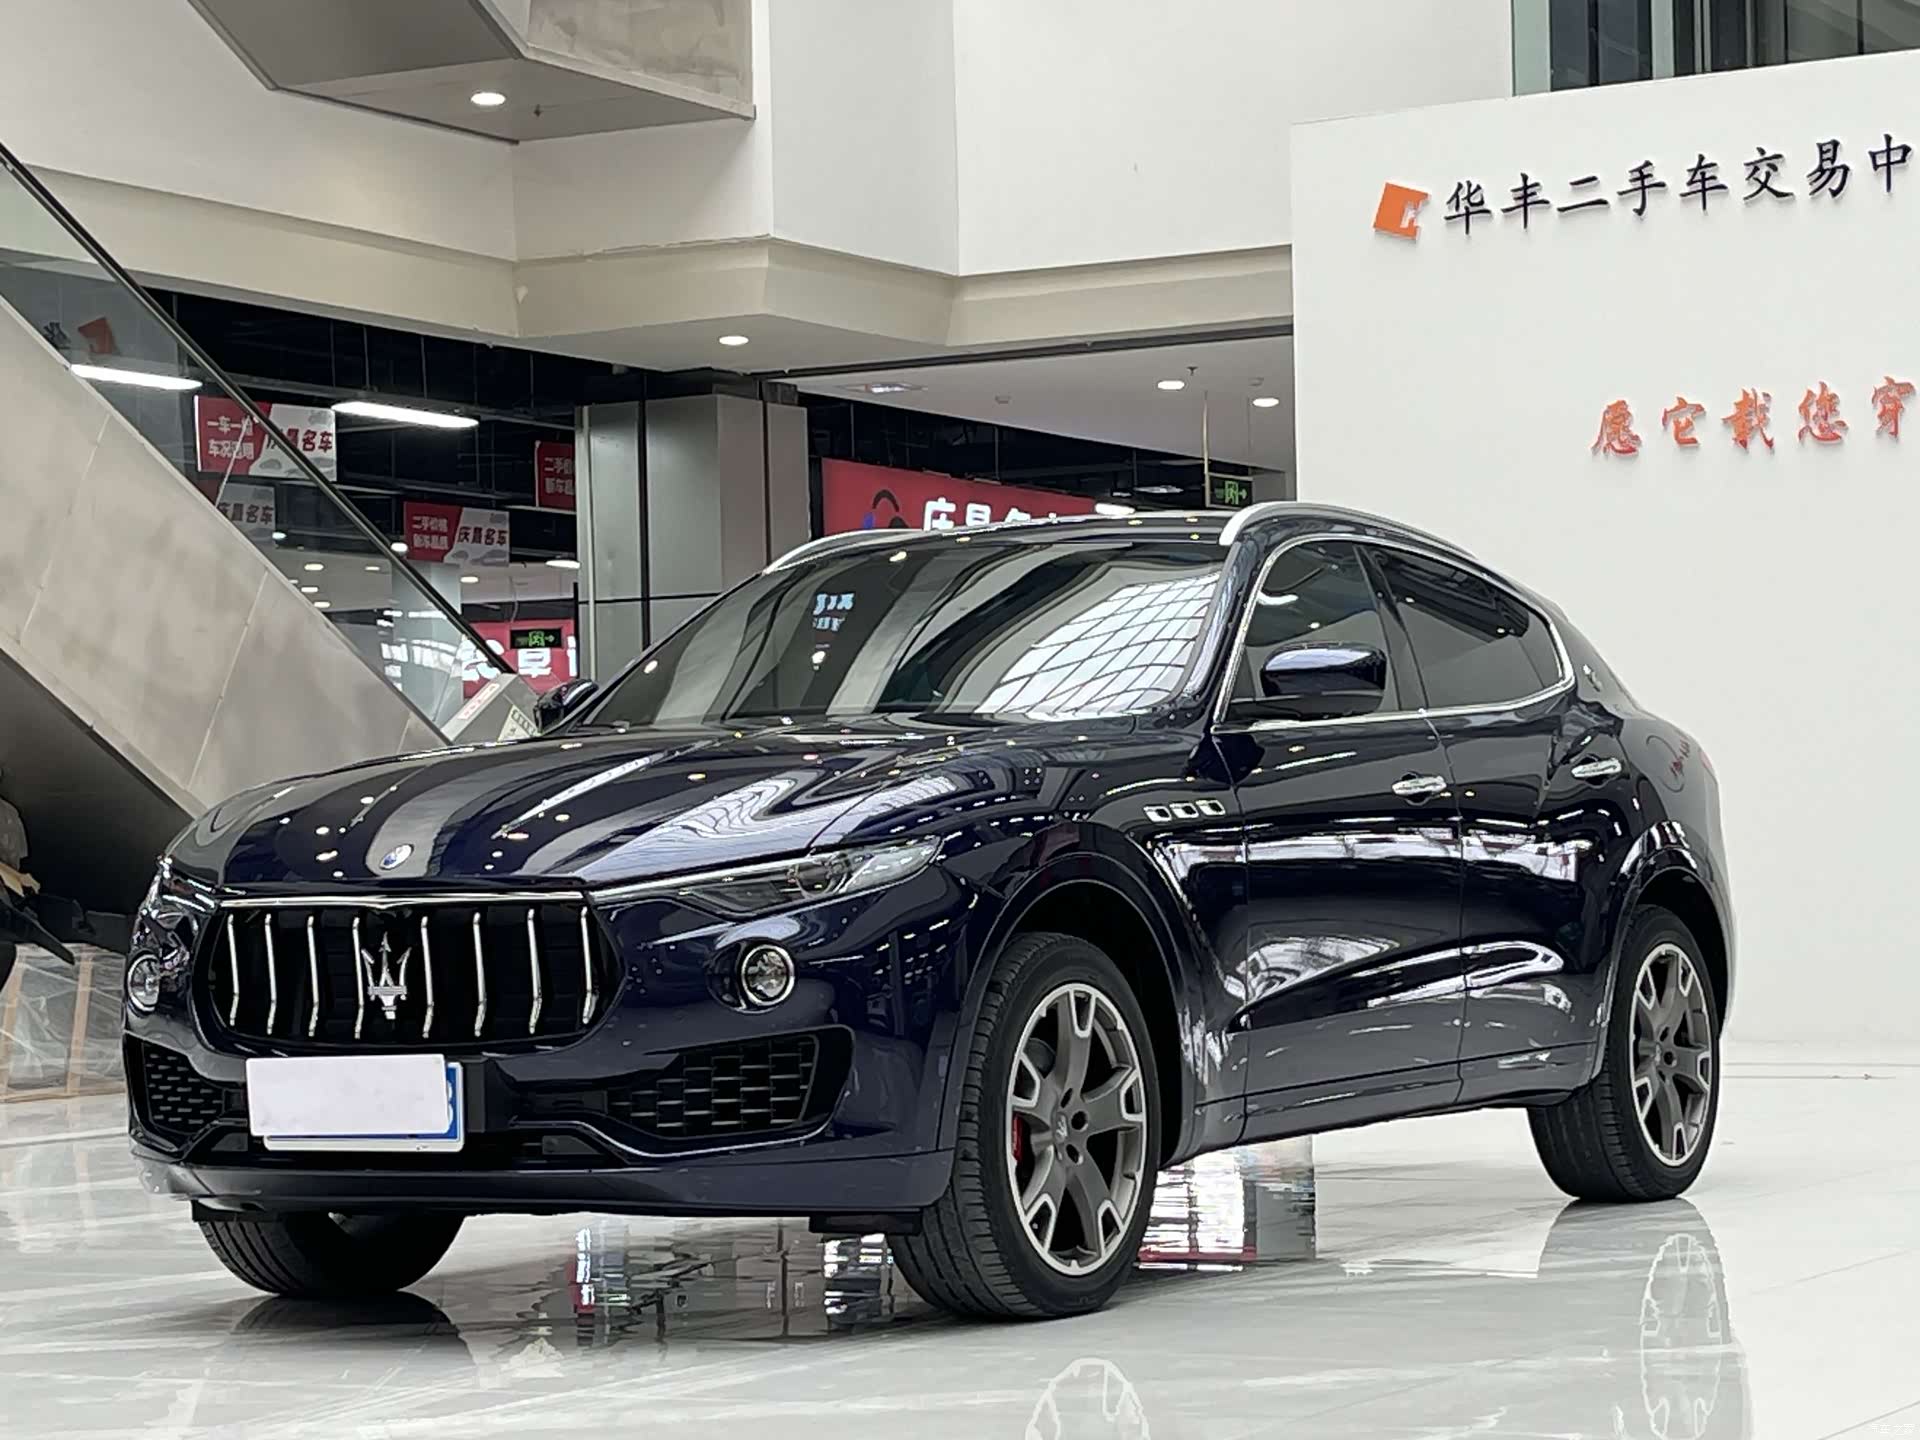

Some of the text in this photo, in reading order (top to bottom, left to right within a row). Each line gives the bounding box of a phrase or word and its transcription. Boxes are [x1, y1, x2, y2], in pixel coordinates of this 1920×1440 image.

[1443, 133, 1913, 236] 华丰二手车交易中
